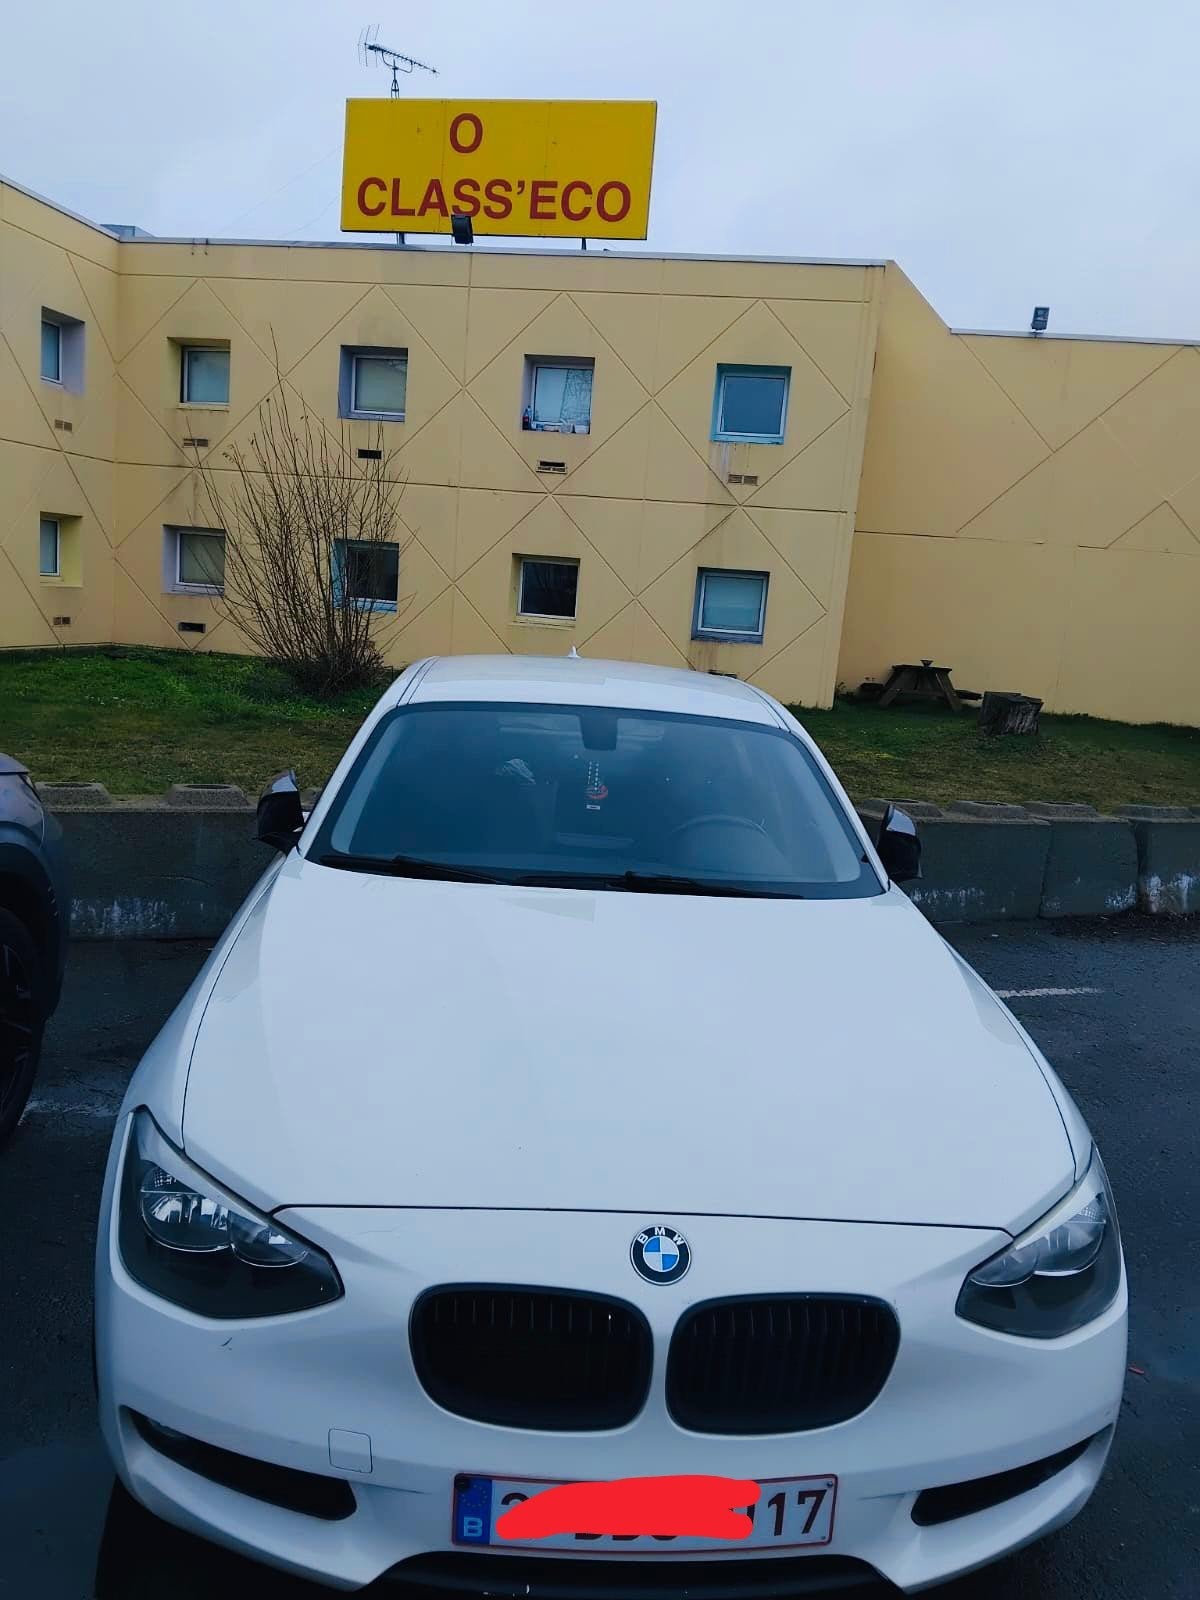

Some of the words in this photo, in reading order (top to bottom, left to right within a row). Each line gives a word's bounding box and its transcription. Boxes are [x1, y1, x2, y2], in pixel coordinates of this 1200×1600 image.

[449, 112, 484, 154] O
[356, 176, 632, 223] CLASS'ECO
[637, 1227, 685, 1246] BMW
[463, 1517, 484, 1537] B
[747, 1489, 827, 1536] 17
